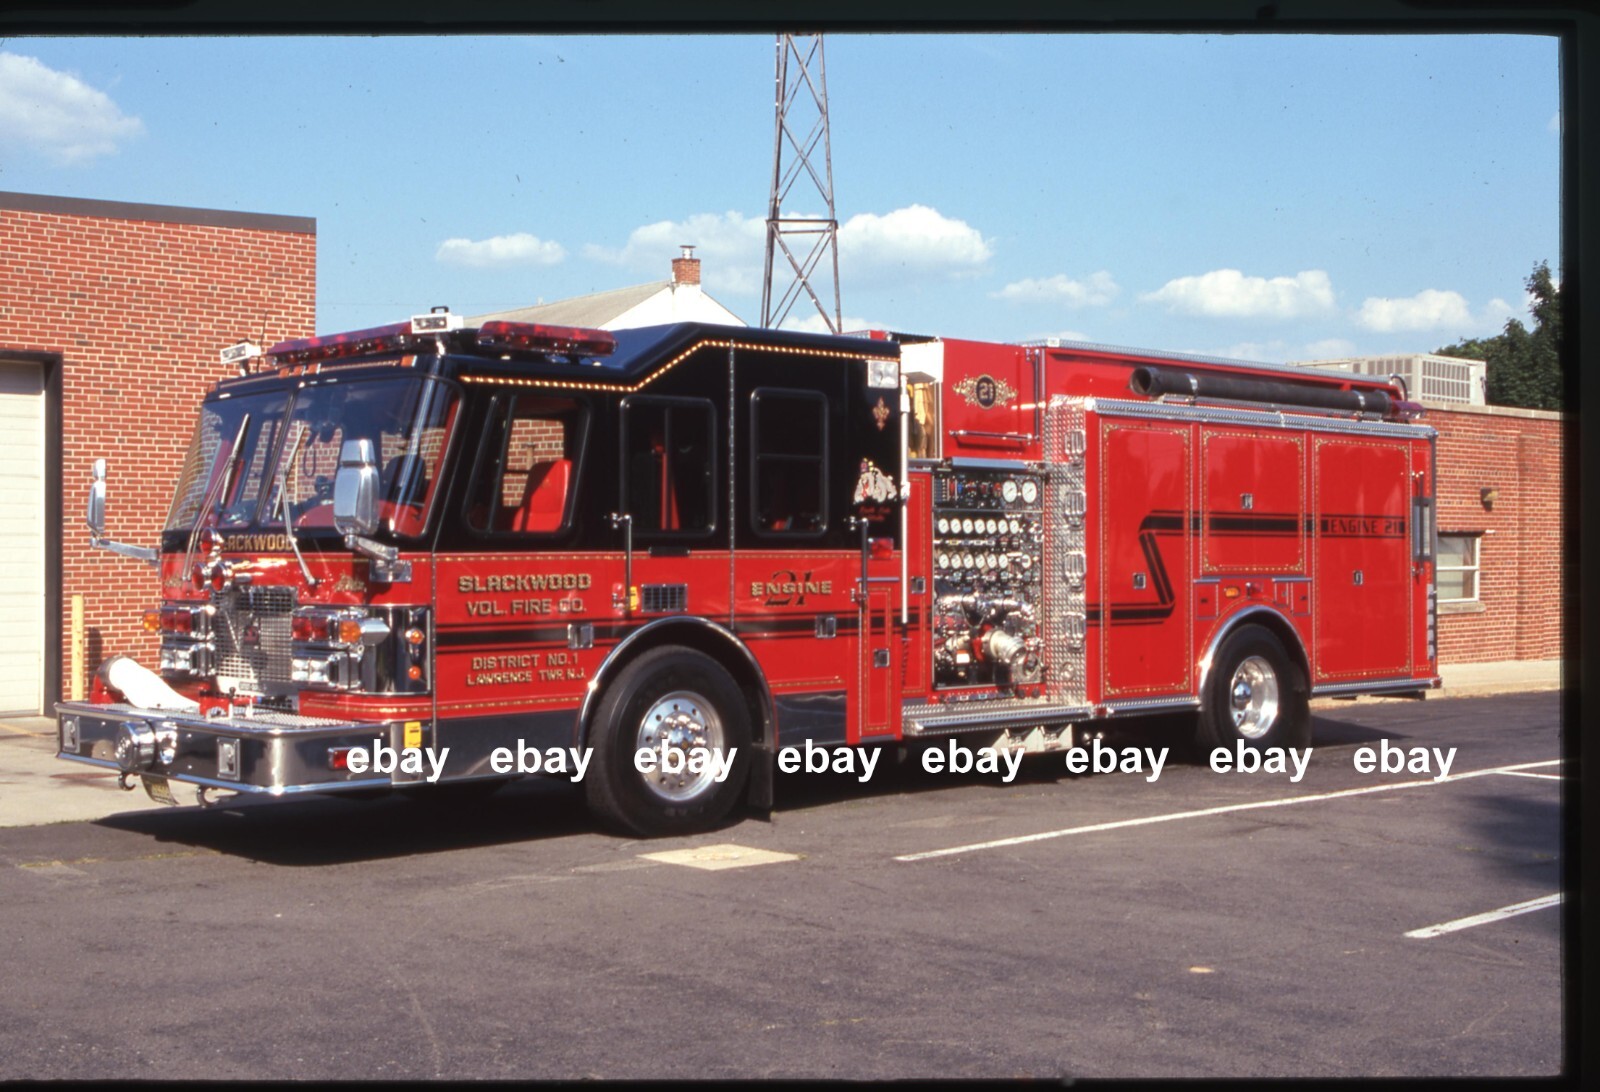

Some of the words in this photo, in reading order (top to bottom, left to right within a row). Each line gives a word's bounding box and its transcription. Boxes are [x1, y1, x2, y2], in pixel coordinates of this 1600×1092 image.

[1331, 519, 1378, 533] ENGINE
[1384, 520, 1398, 533] 21
[458, 573, 592, 592] SLACKWOOD
[751, 580, 832, 596] ENGINE
[466, 600, 508, 616] VOL.
[511, 598, 553, 614] FIRE
[471, 653, 540, 670] DISTRICT
[466, 671, 533, 686] LAWRENCE
